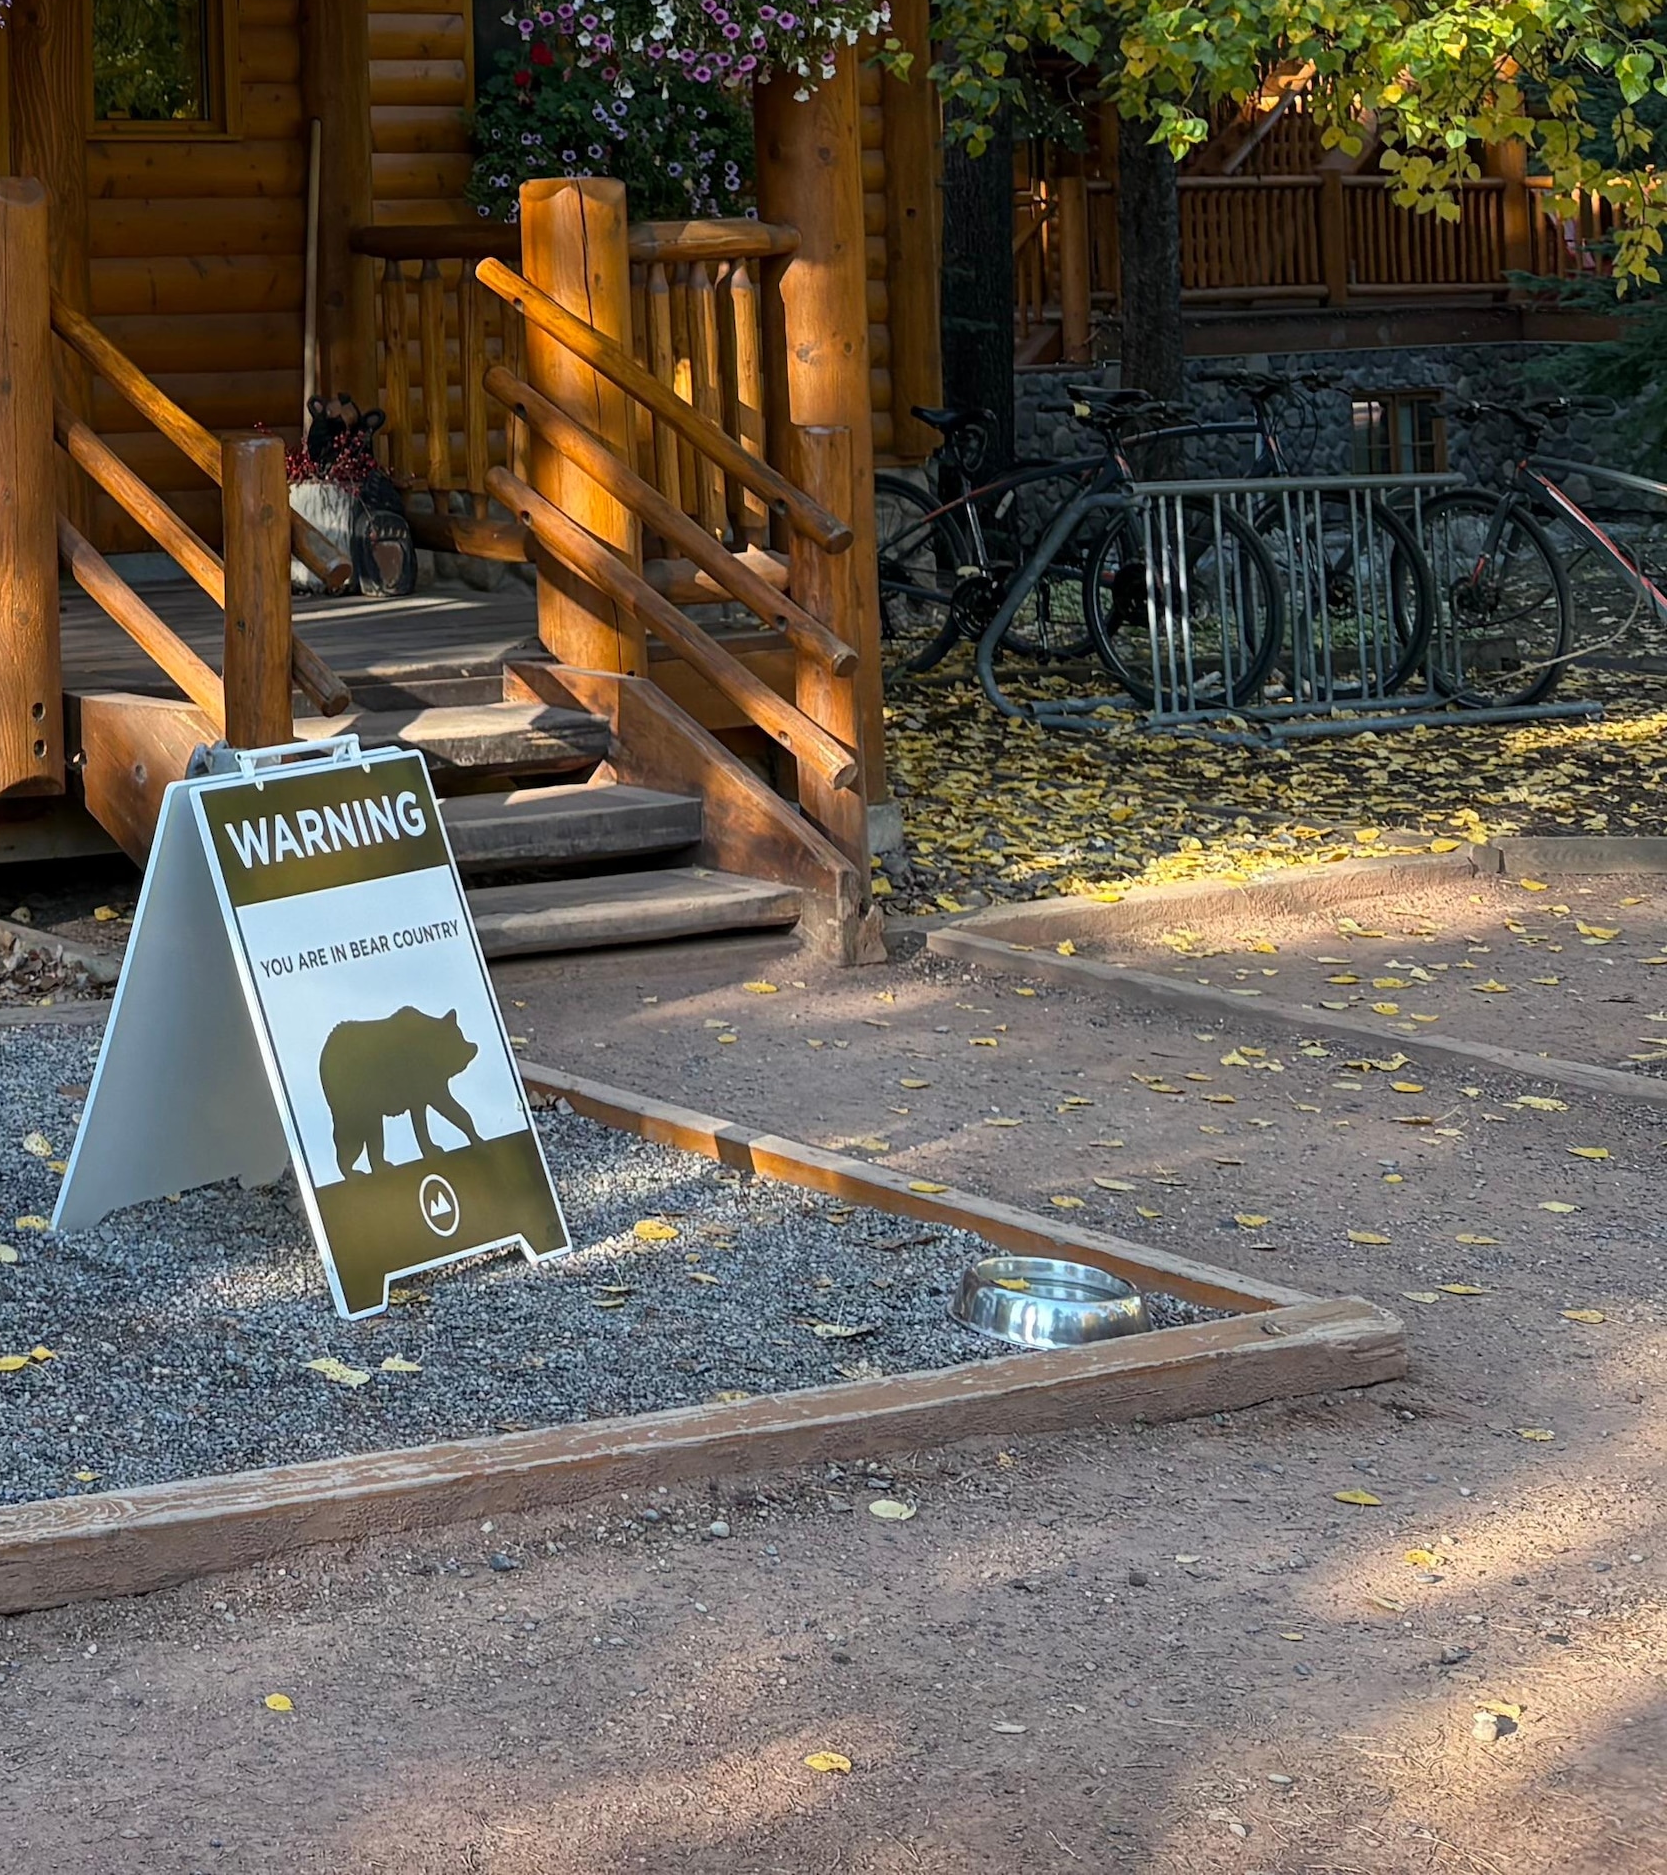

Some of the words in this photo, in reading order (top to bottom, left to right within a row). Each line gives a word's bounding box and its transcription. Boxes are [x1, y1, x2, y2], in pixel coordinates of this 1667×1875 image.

[225, 791, 427, 869] WARNING
[260, 956, 294, 978] YOU
[299, 948, 329, 971] ARE
[330, 944, 348, 963] IN
[349, 935, 391, 959] BEAR
[393, 920, 460, 949] COUNTRY
